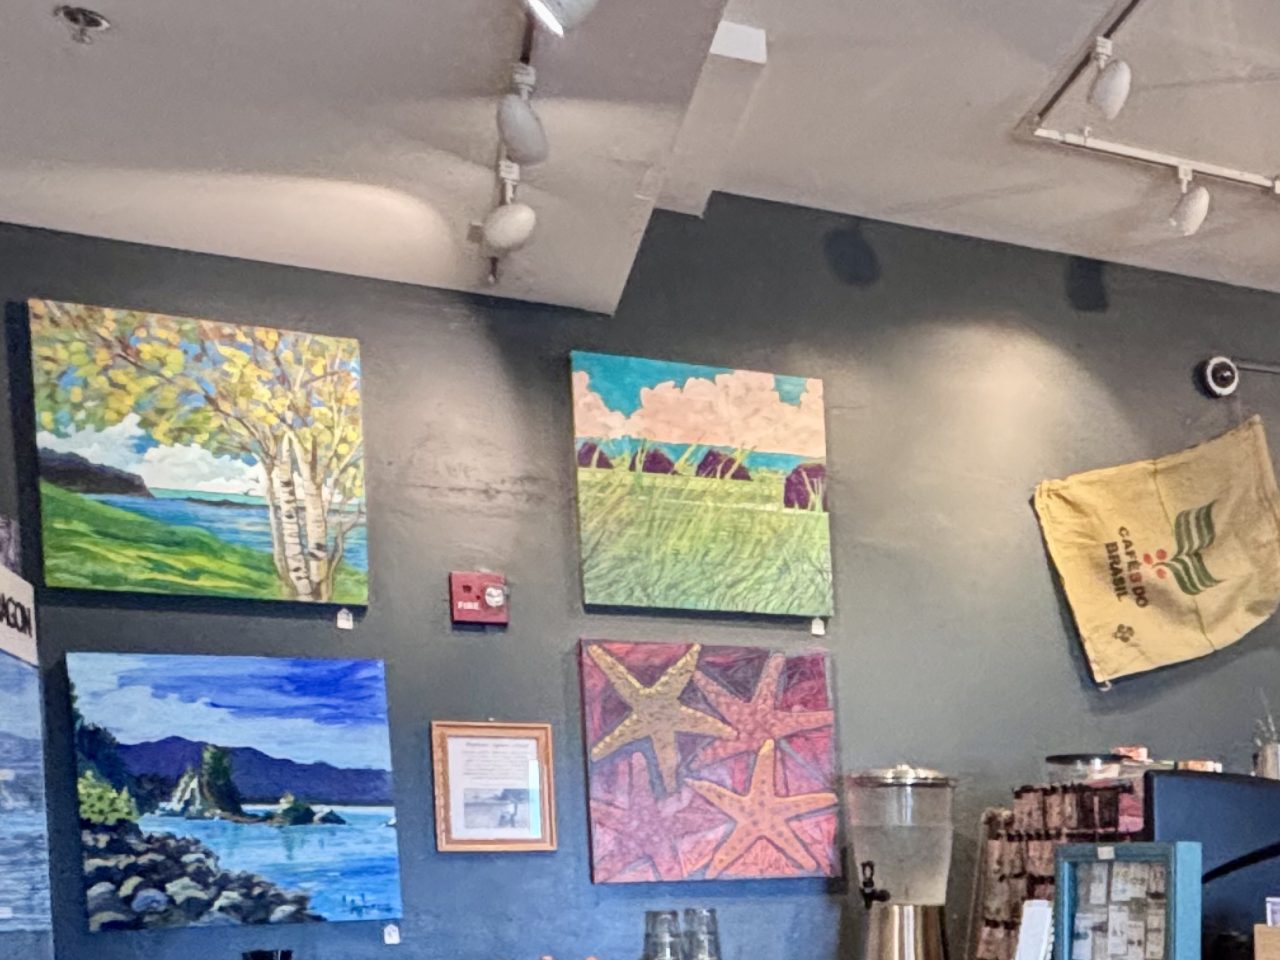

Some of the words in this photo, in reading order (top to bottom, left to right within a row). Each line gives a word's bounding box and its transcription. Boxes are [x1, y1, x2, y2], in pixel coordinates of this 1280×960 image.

[1104, 541, 1128, 602] BRASIL
[457, 601, 480, 610] FIRE
[1132, 585, 1148, 608] DO
